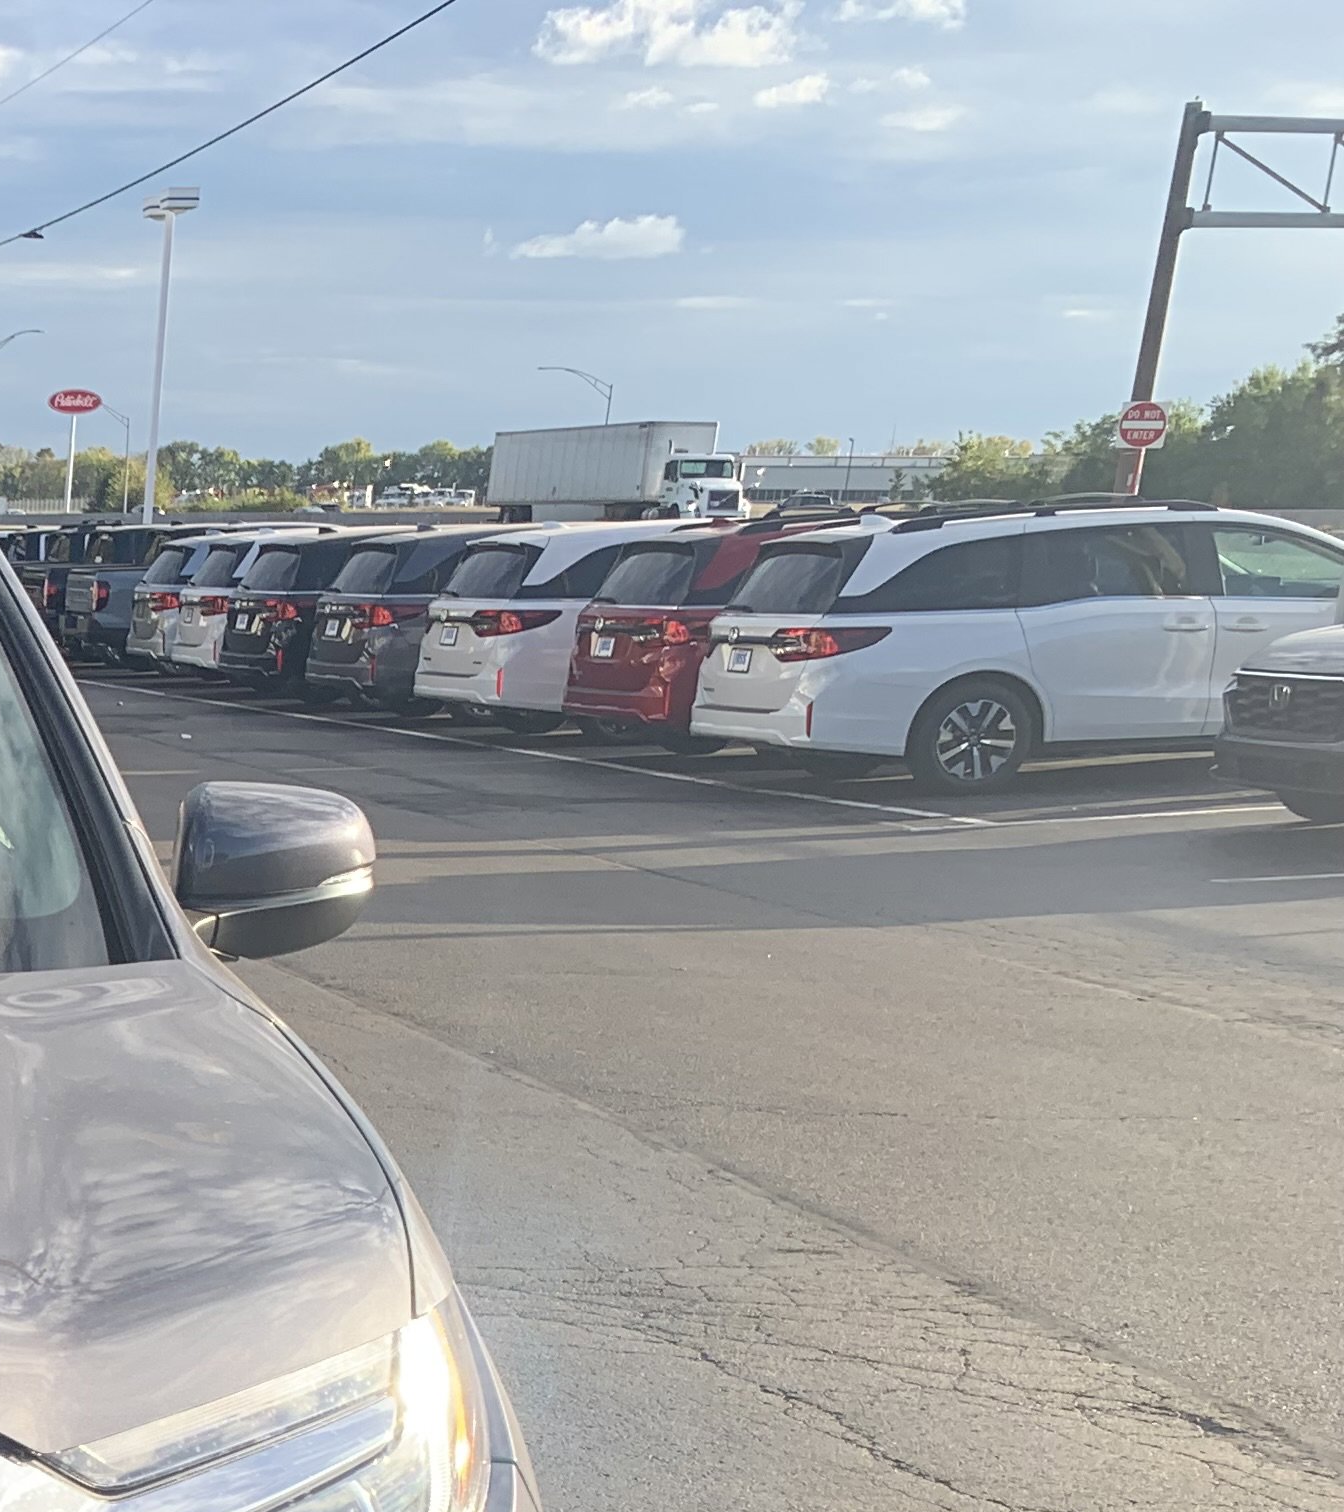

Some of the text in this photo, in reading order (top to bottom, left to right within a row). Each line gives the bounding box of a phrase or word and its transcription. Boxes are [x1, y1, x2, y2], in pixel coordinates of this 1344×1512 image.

[1128, 410, 1162, 420] DO NOT
[1126, 430, 1155, 440] ENTER
